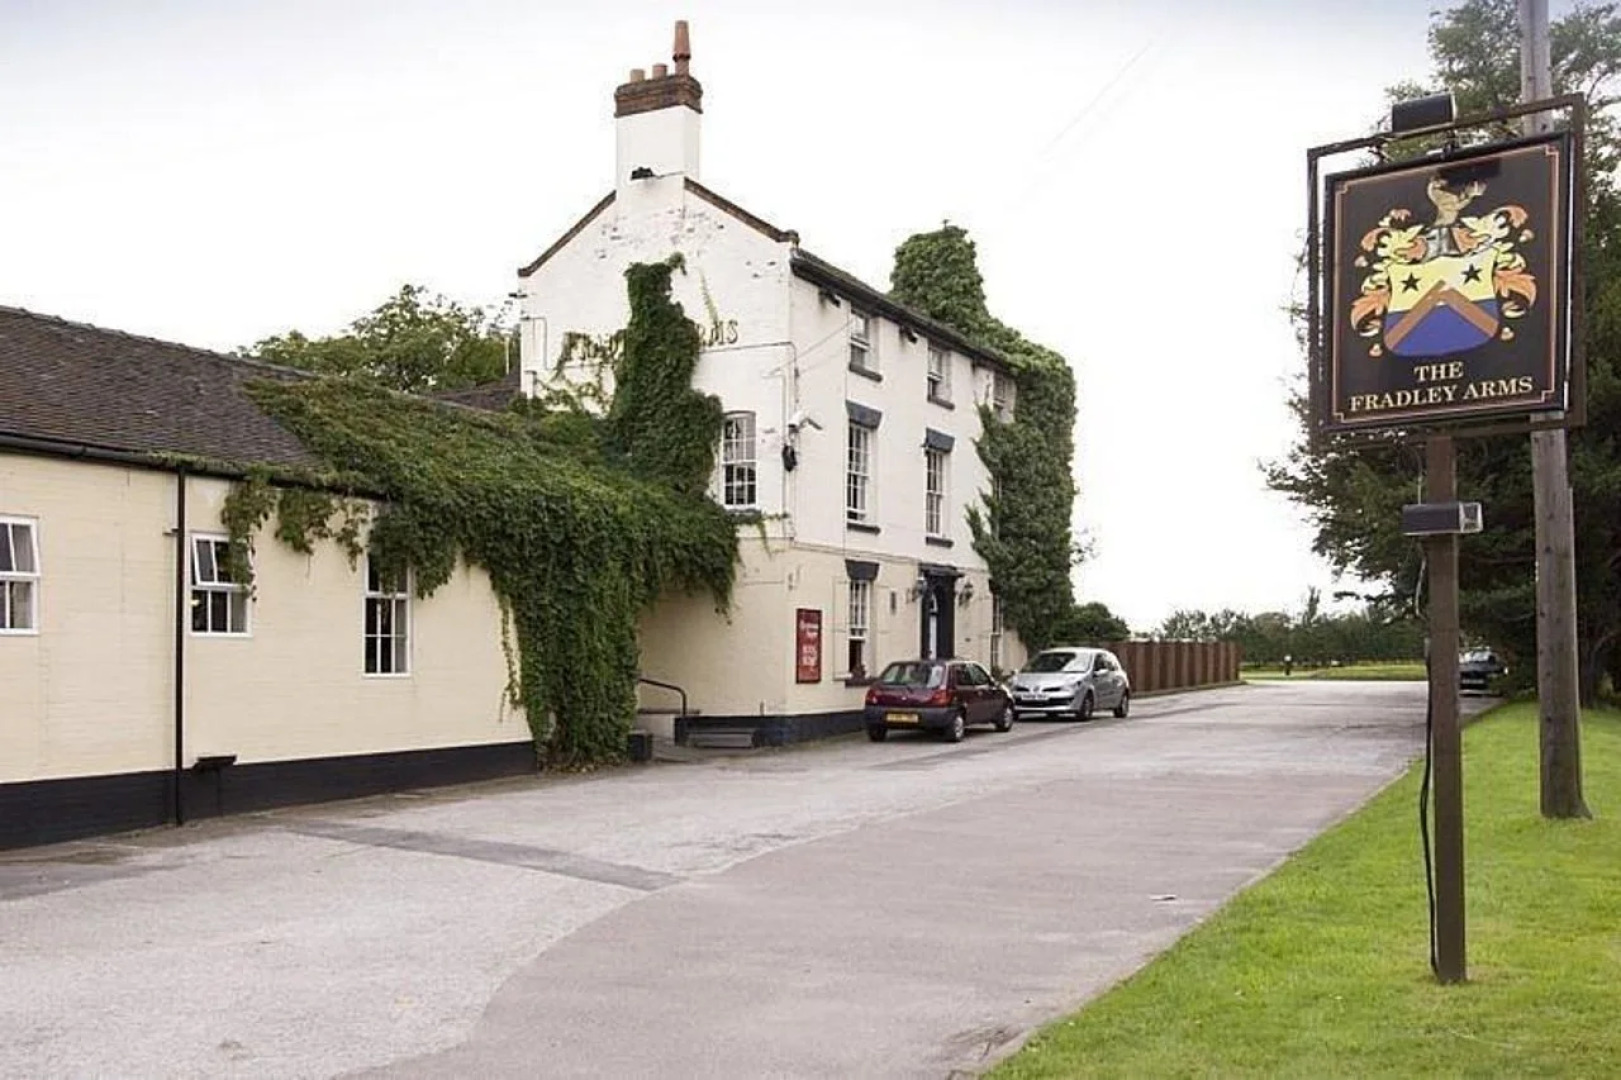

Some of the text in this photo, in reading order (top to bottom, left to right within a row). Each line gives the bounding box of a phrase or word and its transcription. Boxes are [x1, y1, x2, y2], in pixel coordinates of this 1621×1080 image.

[1413, 361, 1464, 382] THE
[1350, 376, 1533, 411] FRADLEY ARMS
